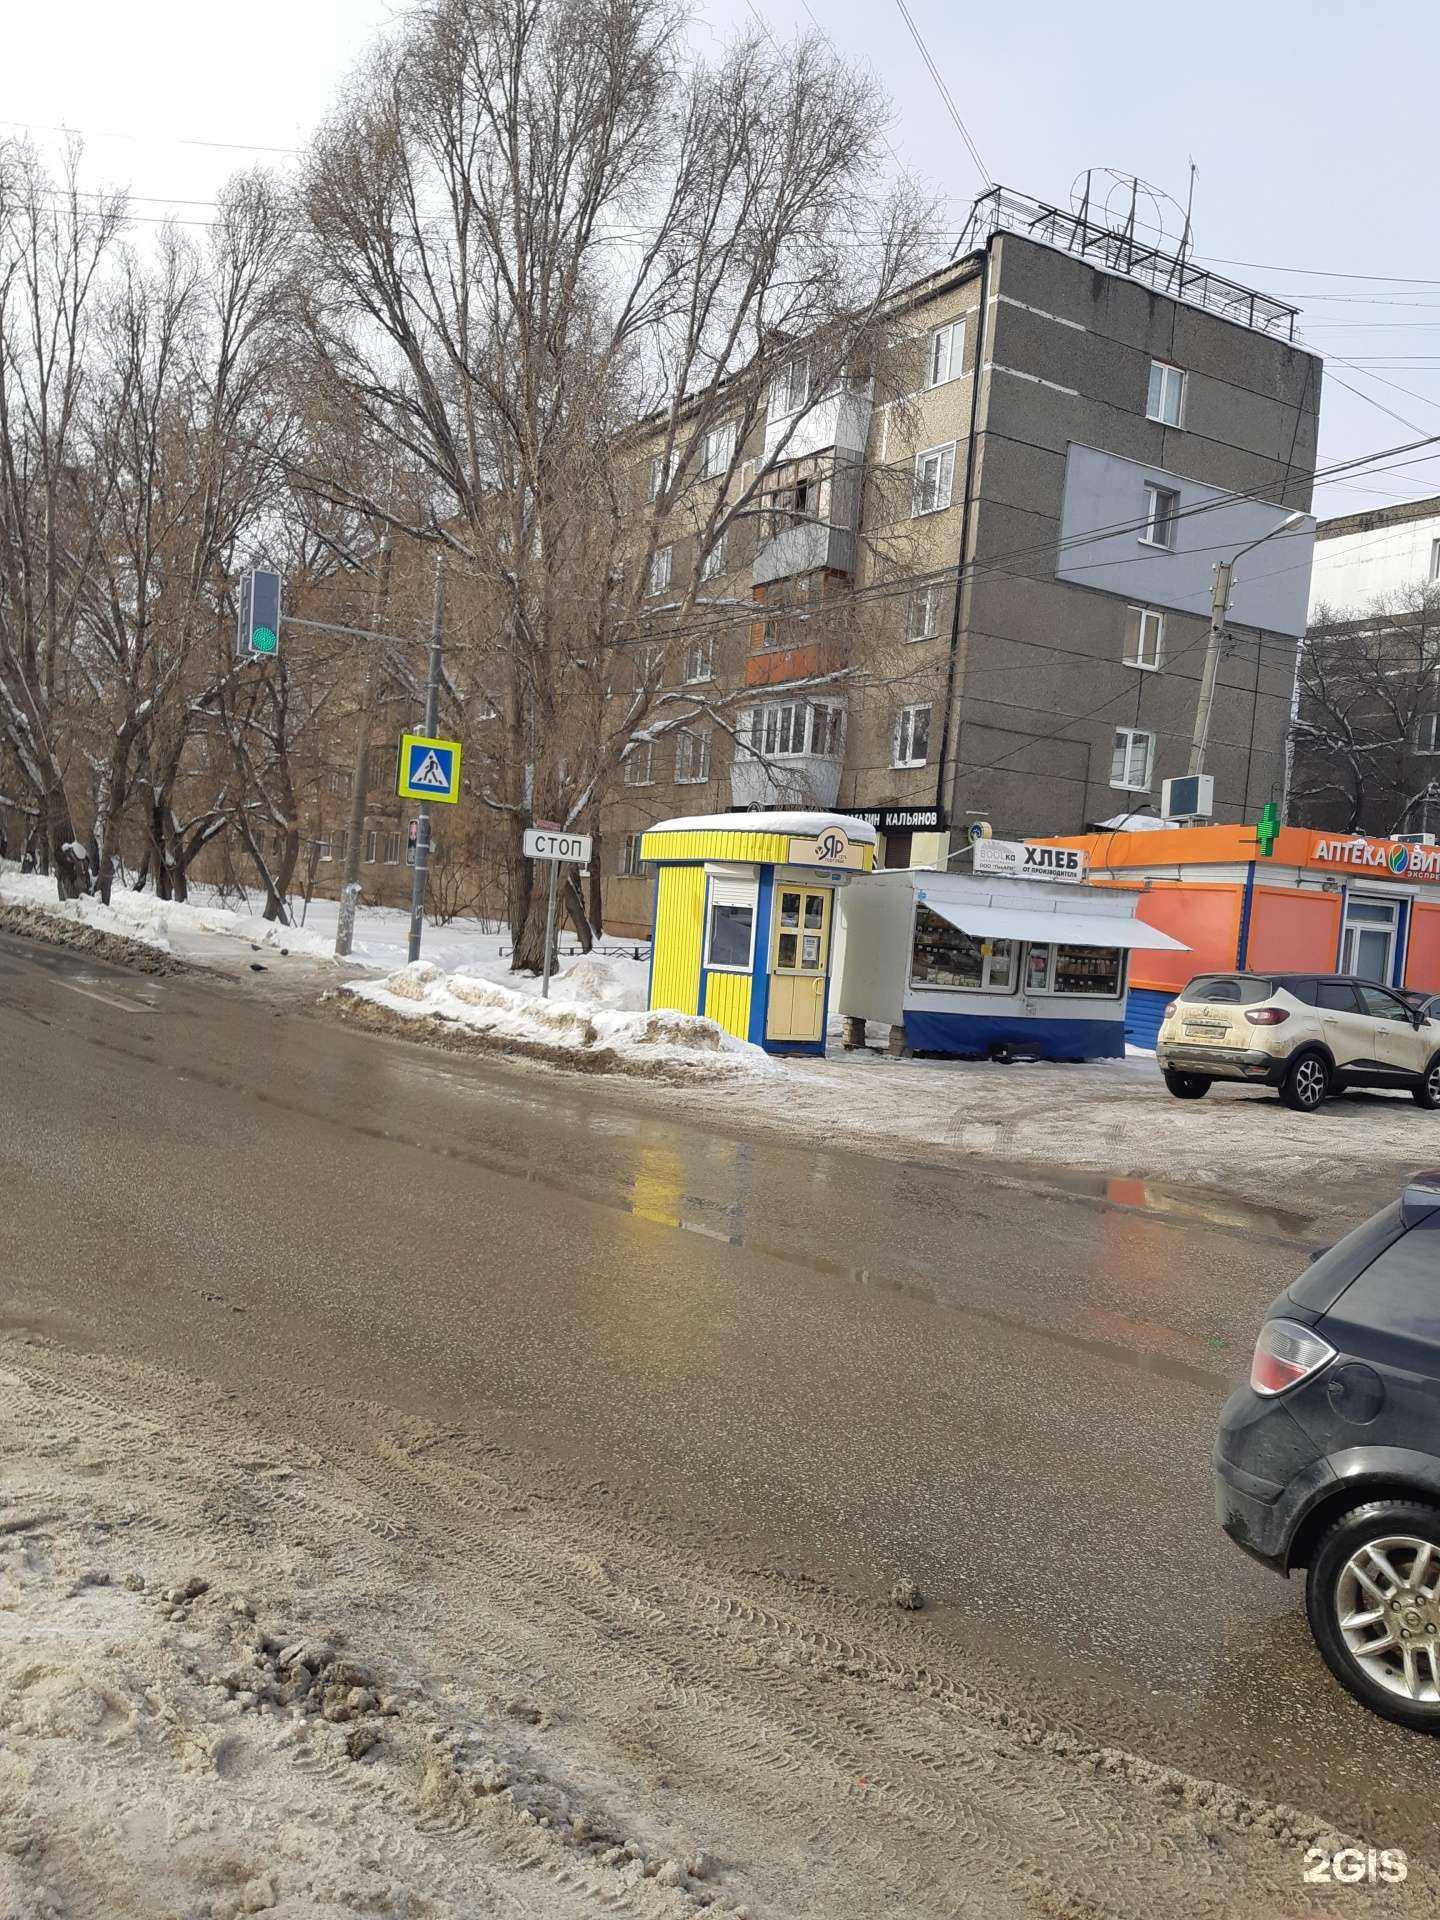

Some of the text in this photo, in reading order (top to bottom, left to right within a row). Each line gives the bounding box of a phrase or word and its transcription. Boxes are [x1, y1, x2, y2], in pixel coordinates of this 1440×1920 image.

[886, 812, 938, 826] КАЛЬЯНОВ
[535, 836, 582, 857] СТОП
[1315, 839, 1387, 867] АПТЕКА
[1024, 847, 1079, 870] ХЛЕБ
[1031, 867, 1078, 878] ПРОИЗВОДИТЕЛЯ
